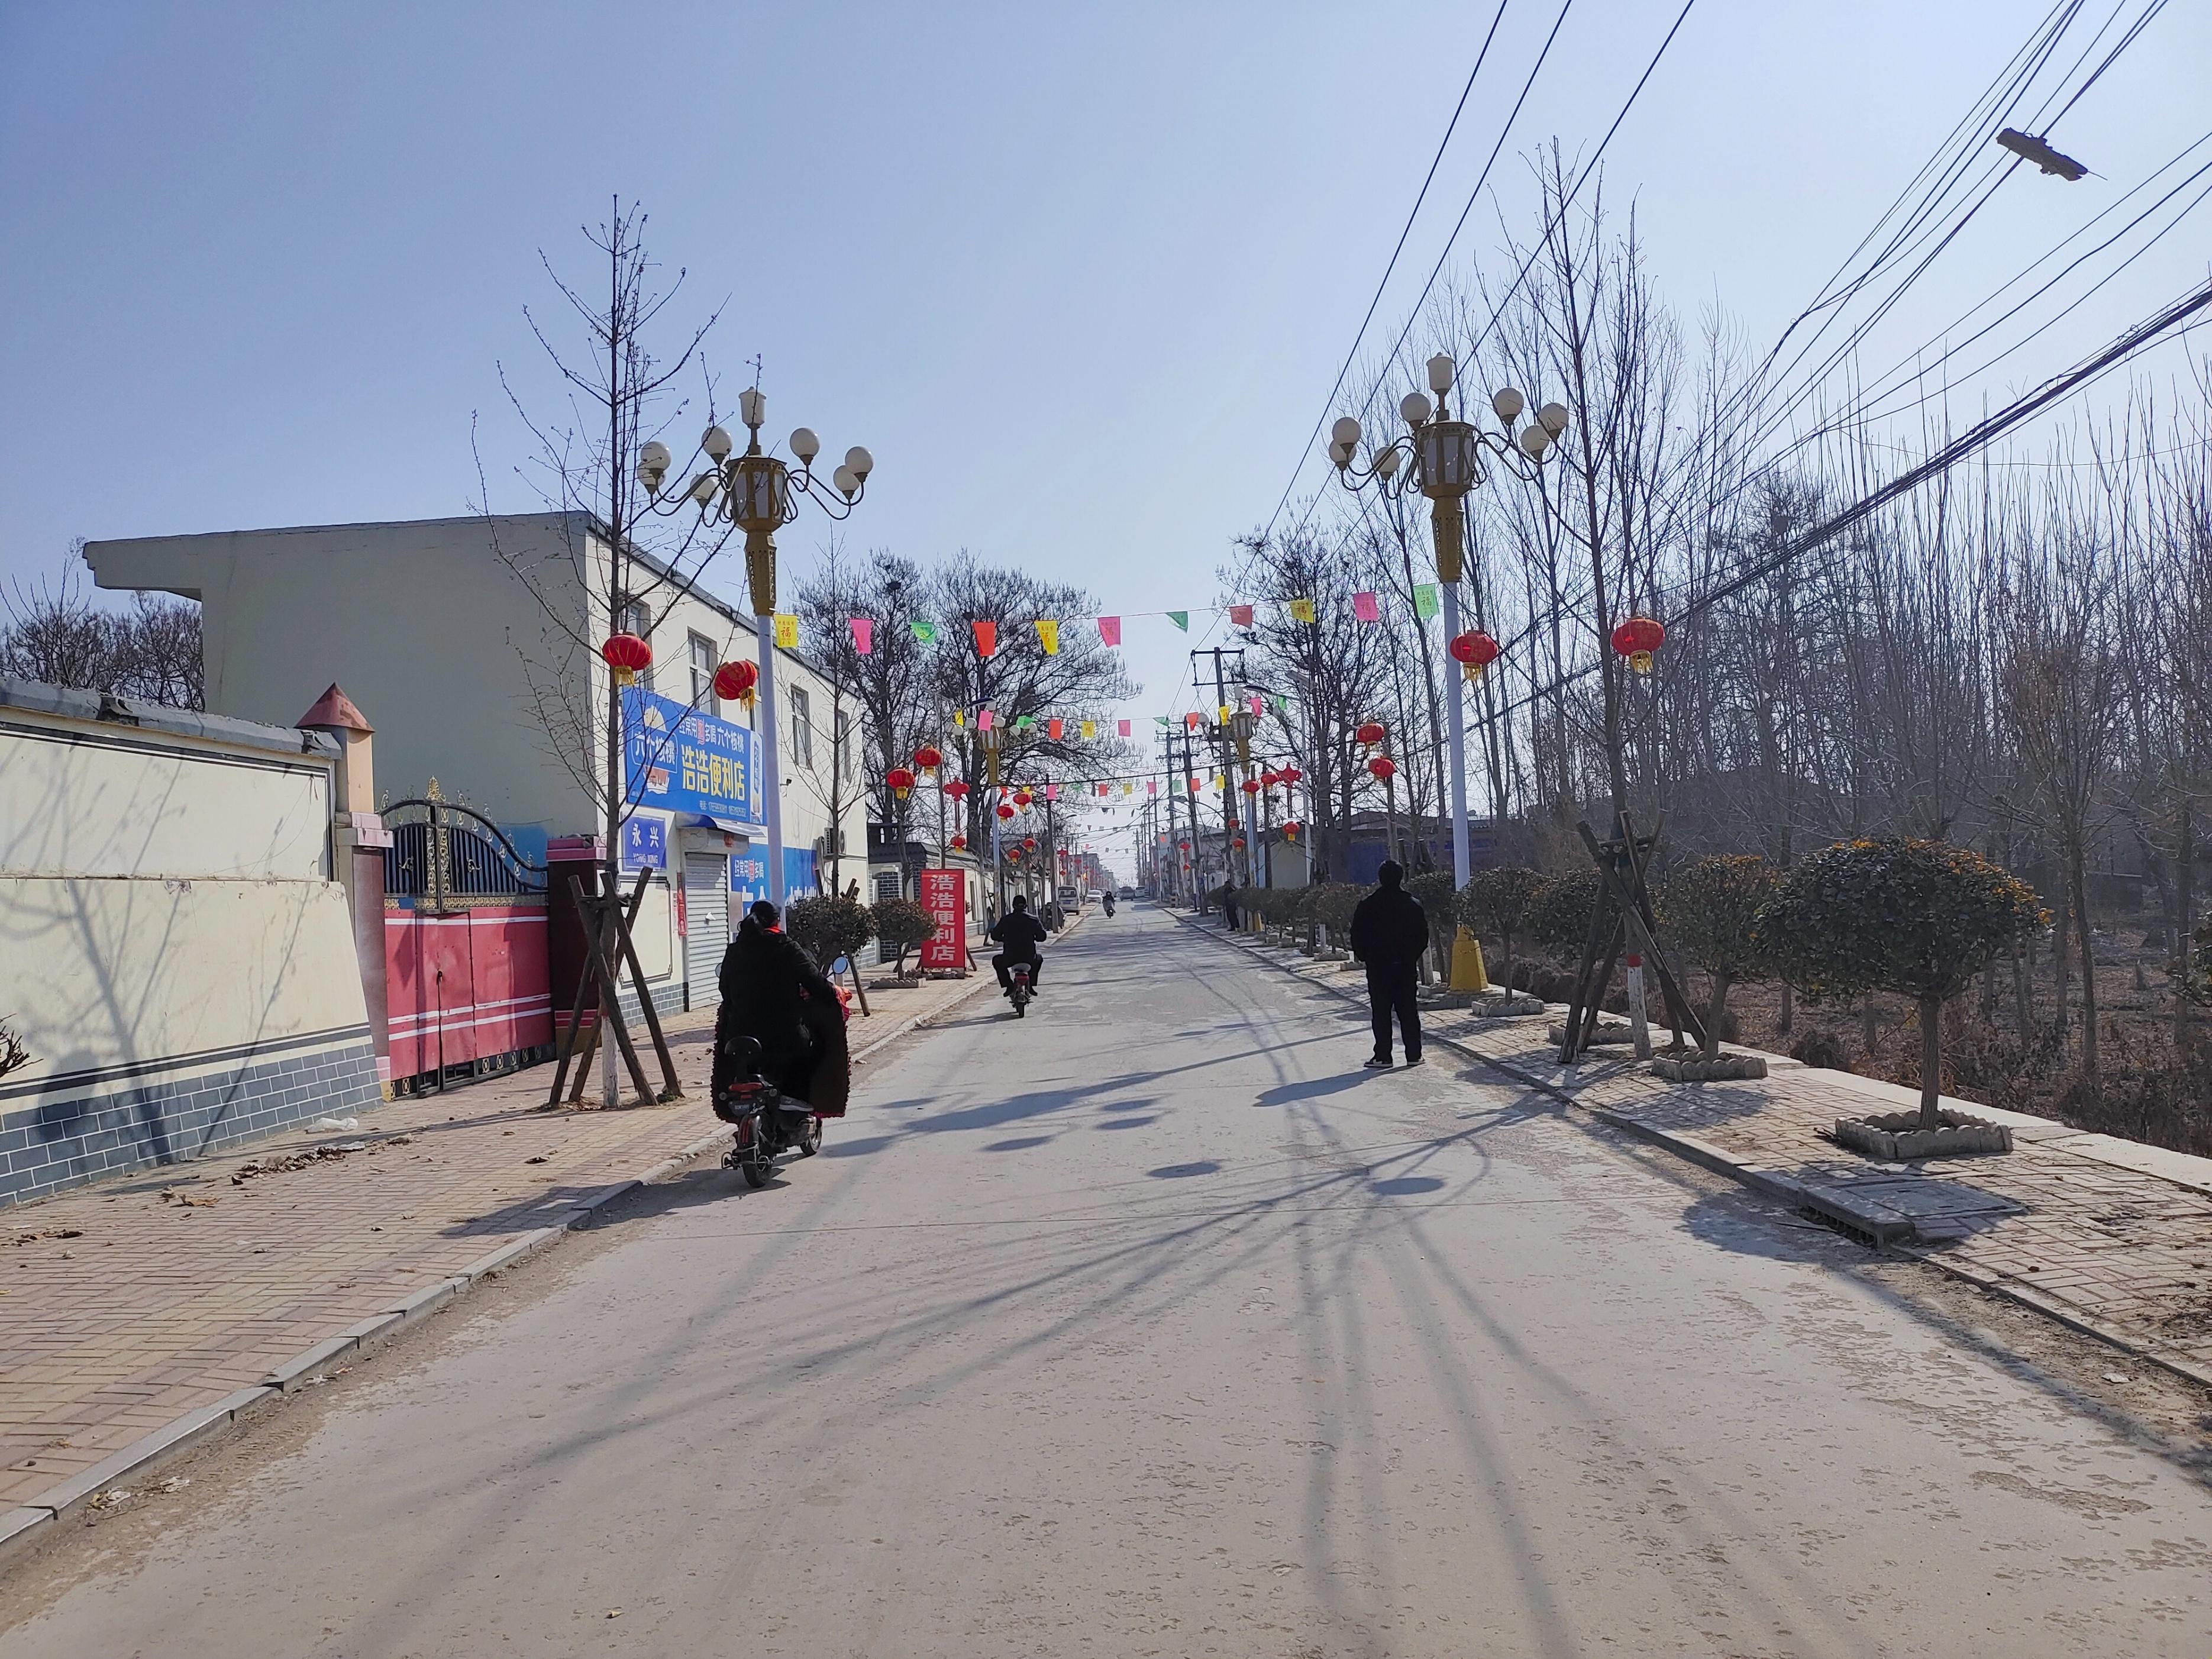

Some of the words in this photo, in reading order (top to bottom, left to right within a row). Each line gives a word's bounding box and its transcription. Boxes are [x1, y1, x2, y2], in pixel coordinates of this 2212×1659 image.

[780, 627, 792, 638] 福
[634, 731, 675, 766] 六个核桃
[681, 744, 745, 802] 浩浩便利店
[632, 822, 660, 848] 永兴
[633, 853, 647, 863] YONG
[647, 854, 658, 864] XING
[929, 874, 957, 961] 浩浩便利店
